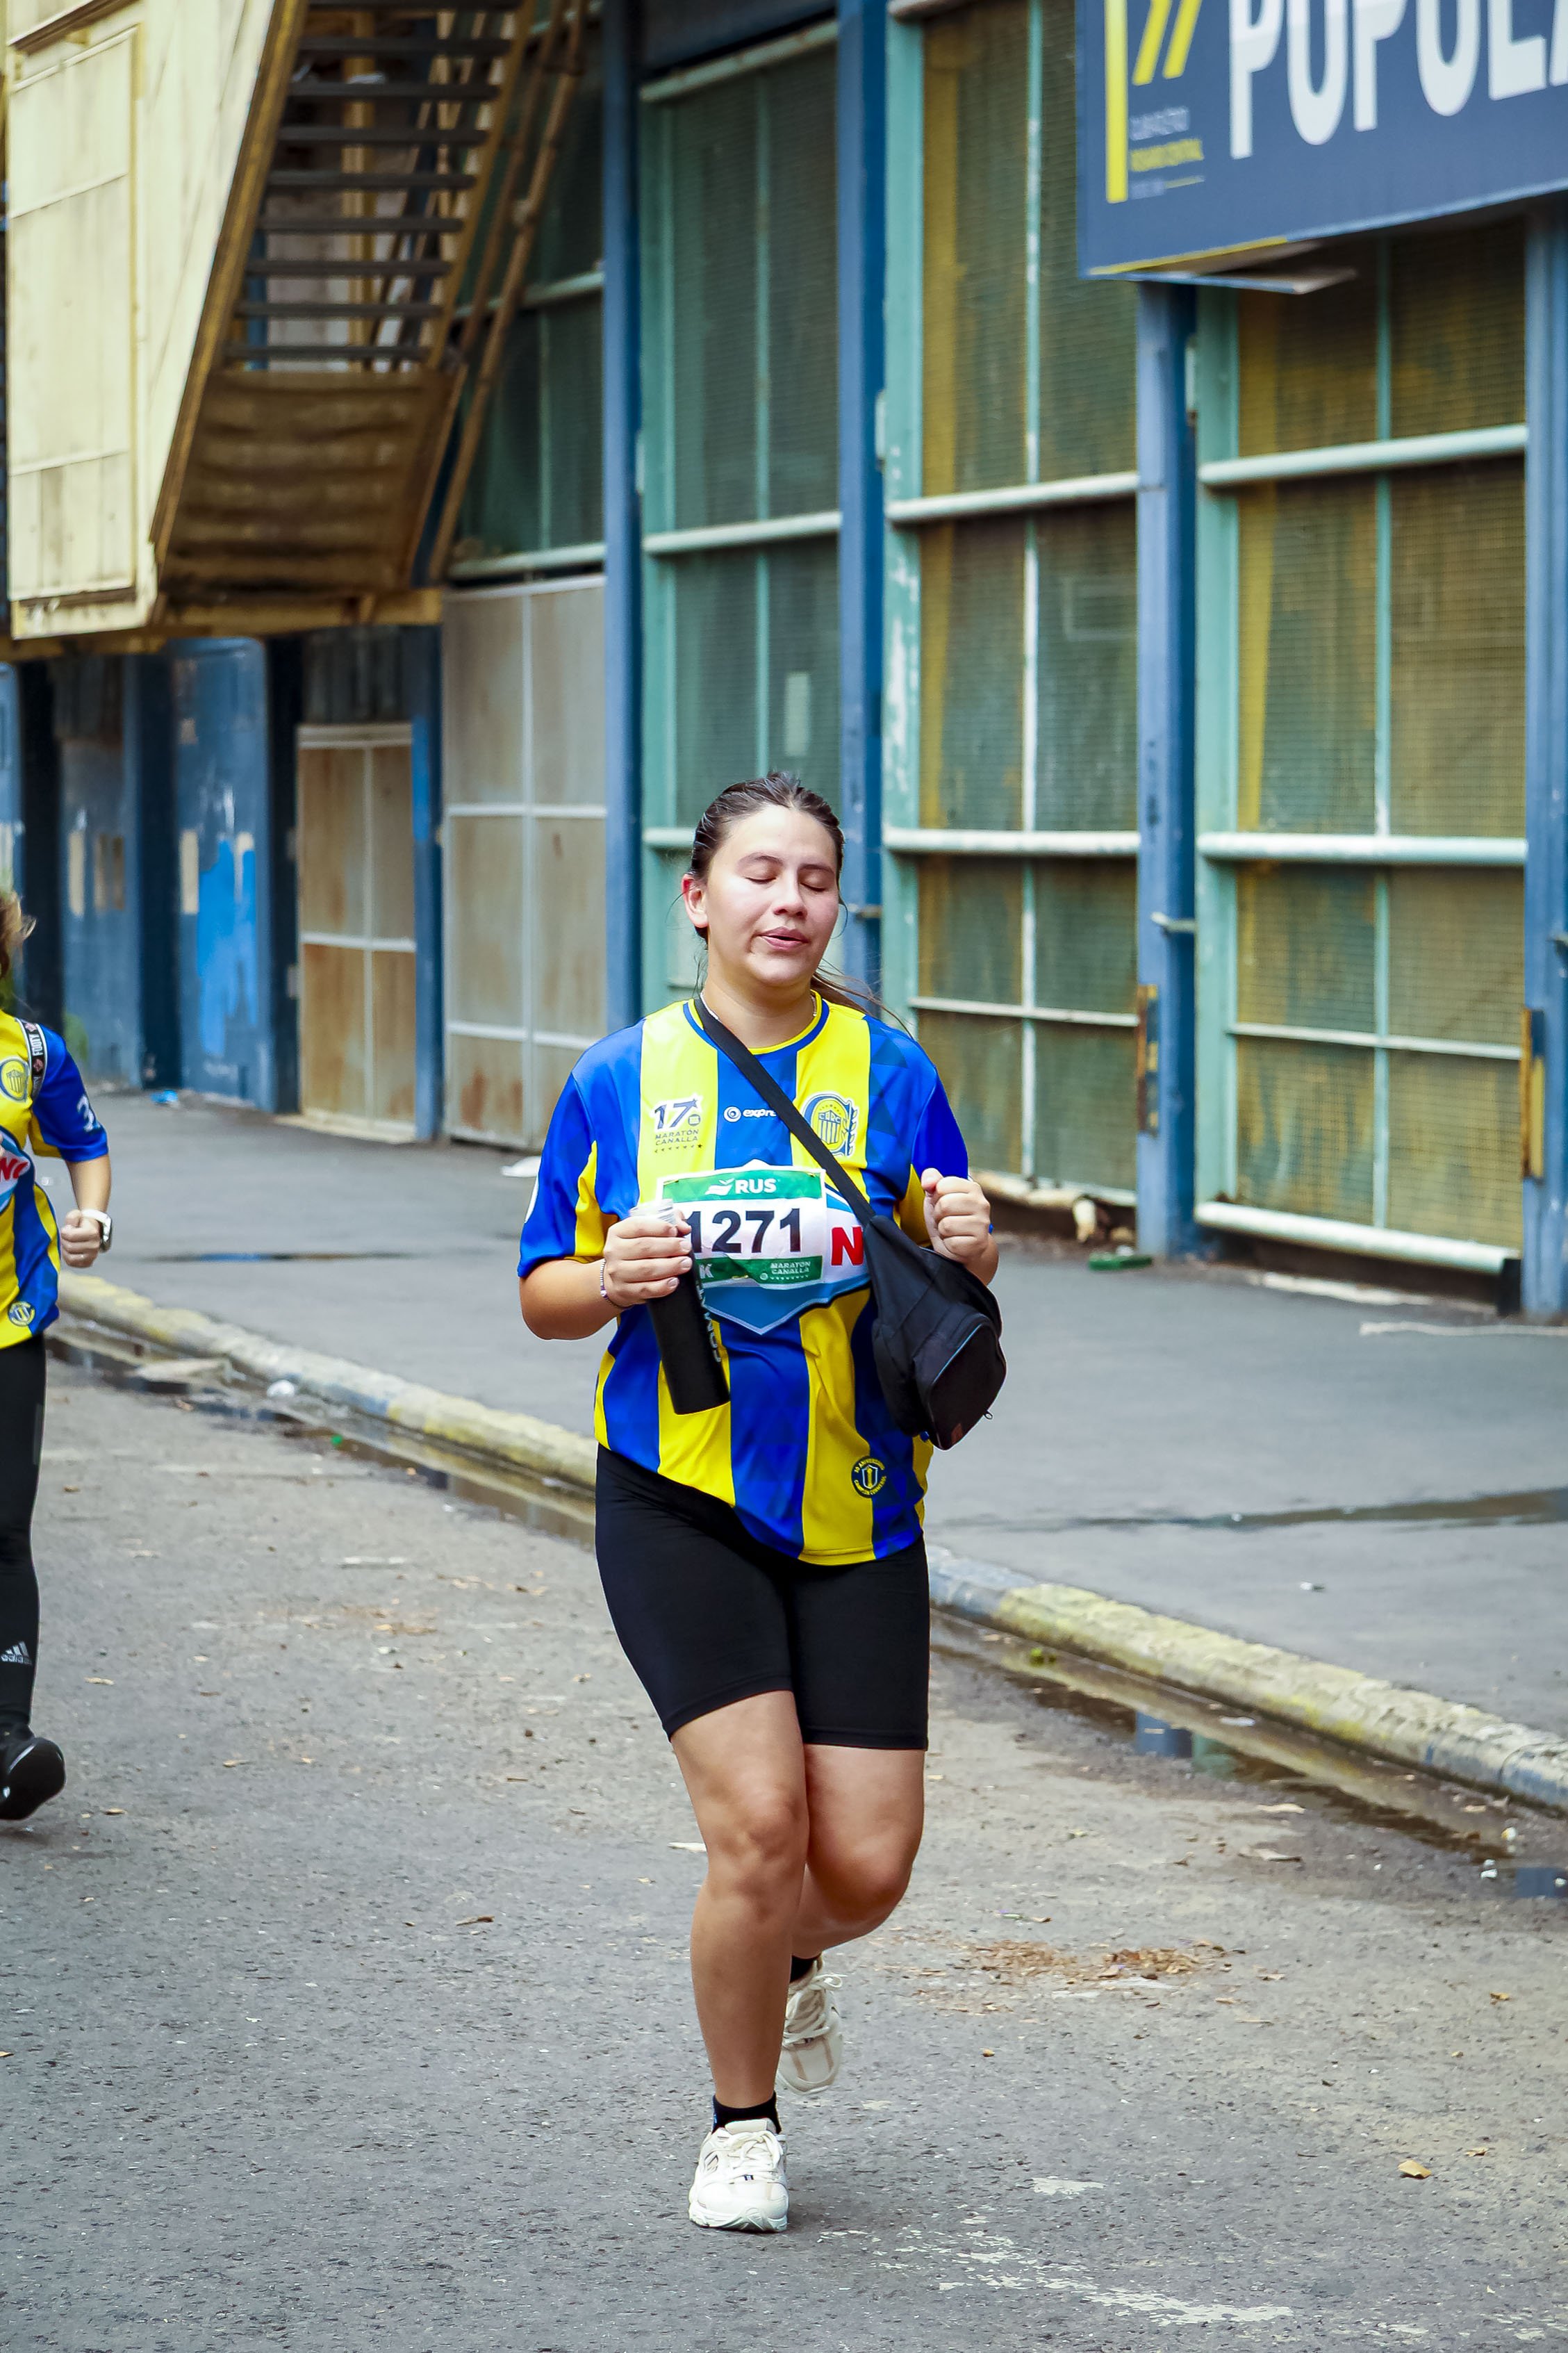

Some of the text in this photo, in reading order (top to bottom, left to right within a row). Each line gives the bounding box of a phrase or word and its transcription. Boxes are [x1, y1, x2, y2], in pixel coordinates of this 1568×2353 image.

[1229, 0, 1568, 159] POPUL
[655, 1135, 698, 1146] CANALLA
[735, 1178, 777, 1195] RUS
[686, 1208, 801, 1254] 1271
[771, 1267, 809, 1275] CANALLA
